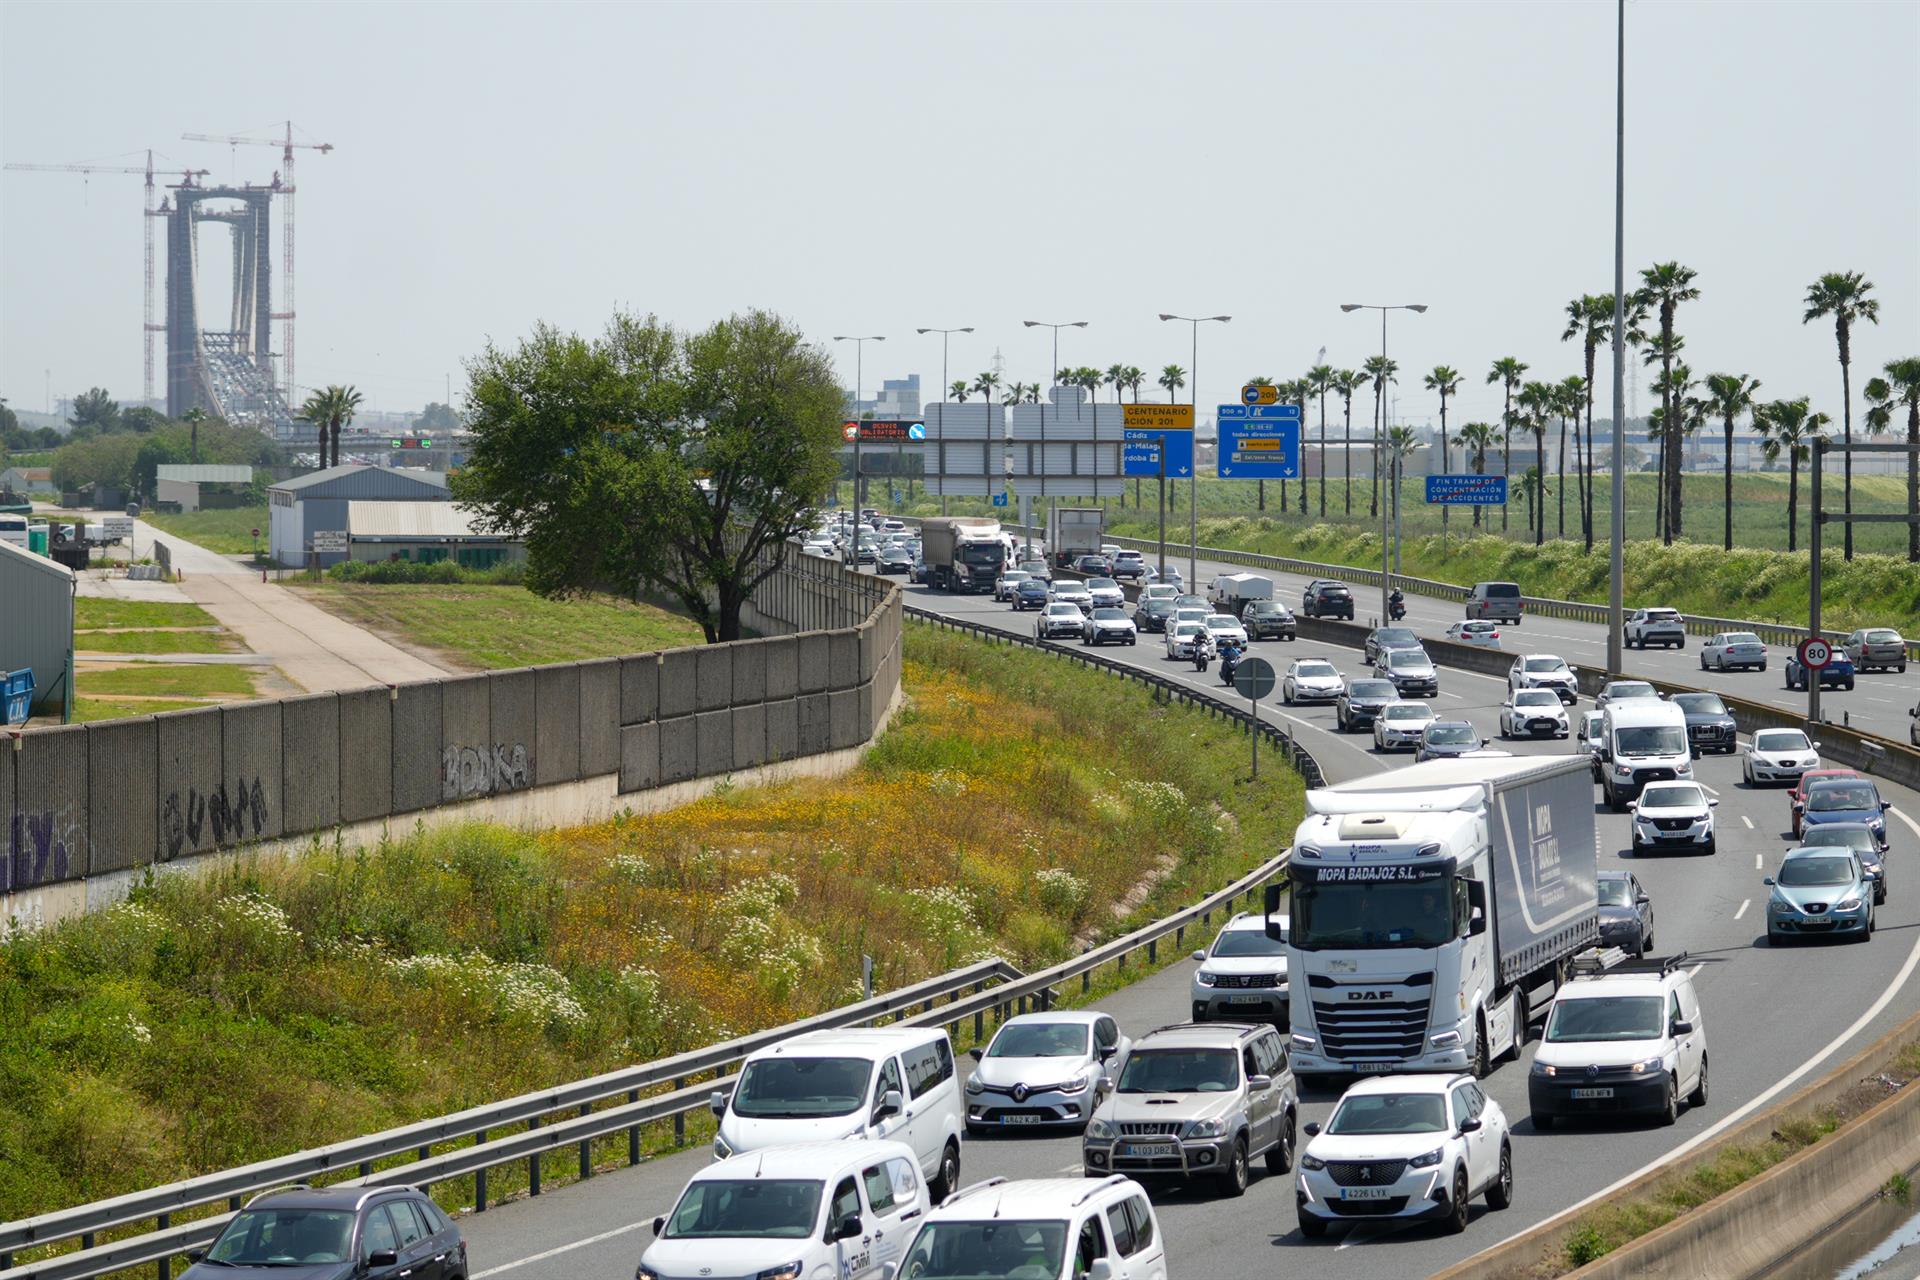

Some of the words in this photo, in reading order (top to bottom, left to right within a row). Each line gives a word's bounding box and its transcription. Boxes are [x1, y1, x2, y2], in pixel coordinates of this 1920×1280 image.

[1127, 407, 1188, 415] CENTENARIO
[1808, 648, 1826, 658] 80
[1317, 868, 1346, 881] MOPA
[1348, 867, 1396, 880] BADAJOZ
[1398, 866, 1416, 879] S.L.
[1348, 991, 1394, 1000] DAF
[1132, 1146, 1152, 1155] 4103
[1348, 1190, 1369, 1198] 4226
[1370, 1189, 1387, 1198] LYX
